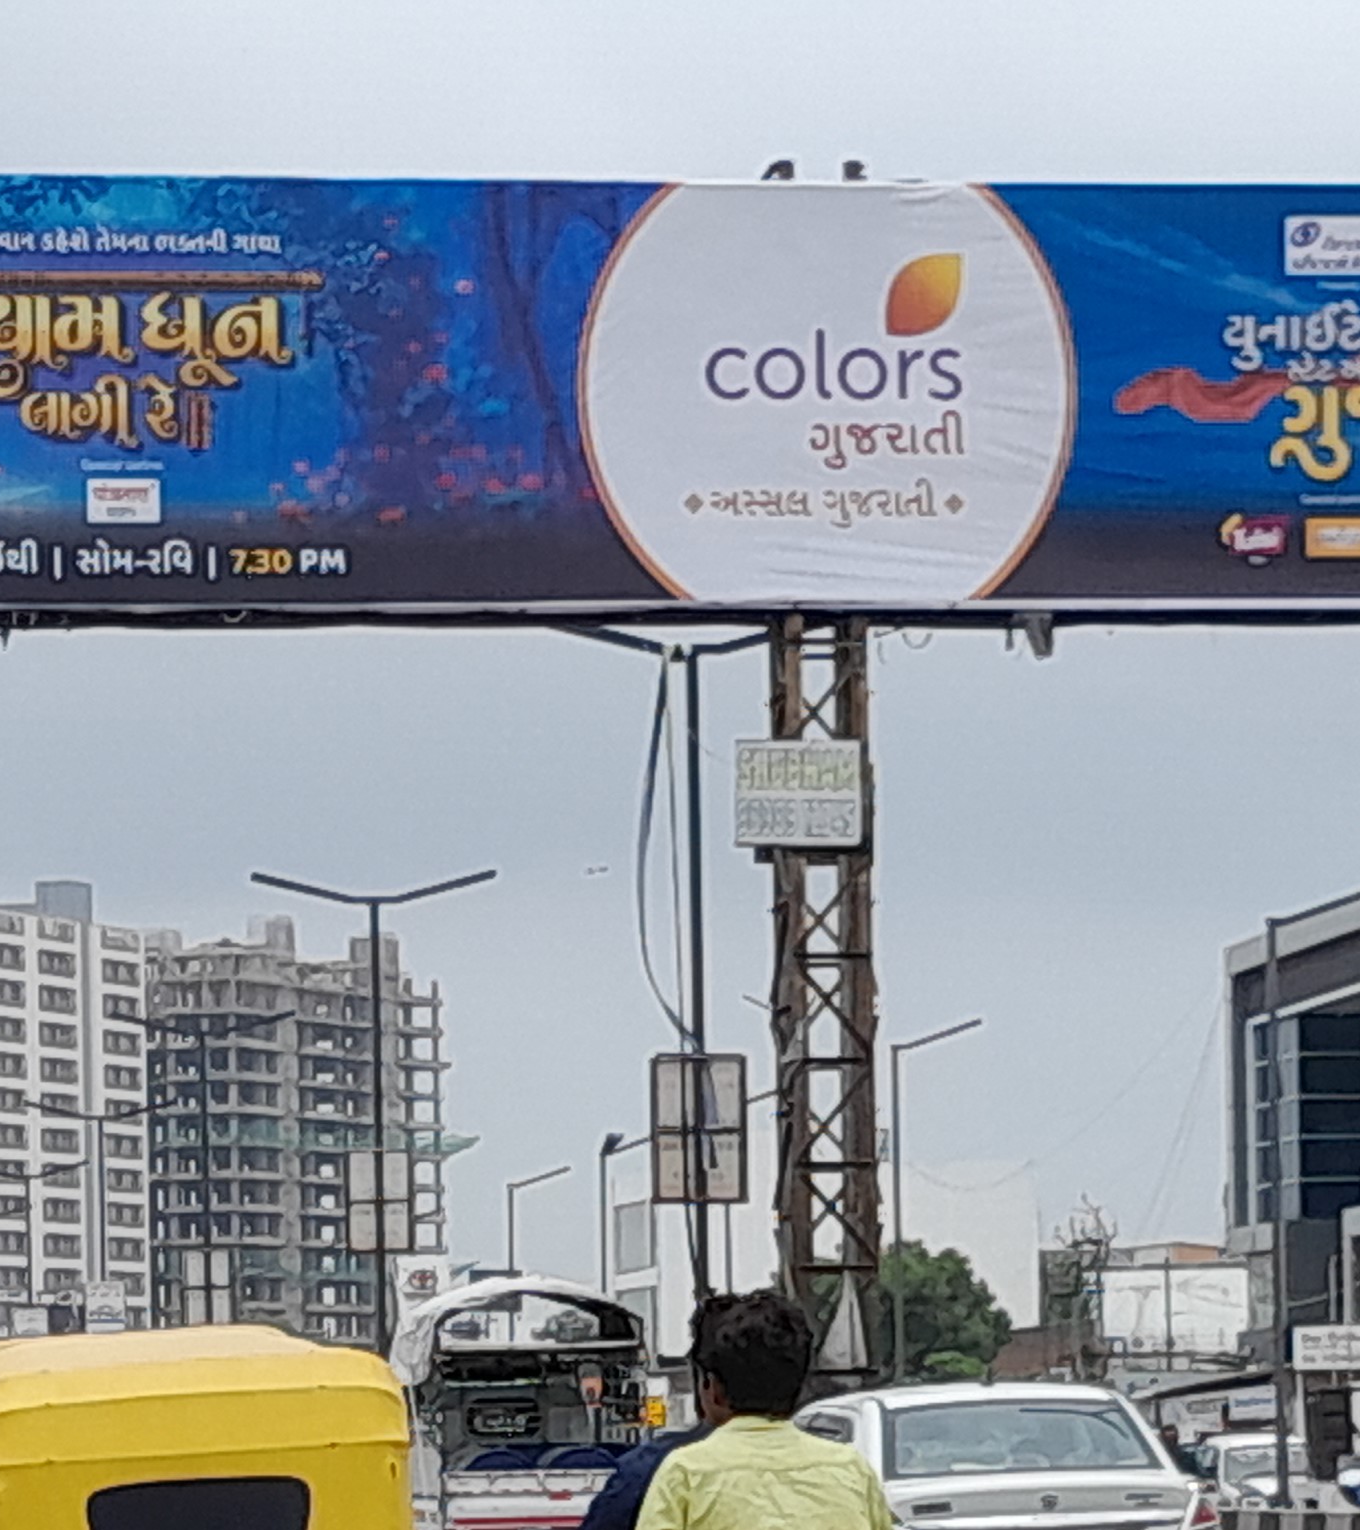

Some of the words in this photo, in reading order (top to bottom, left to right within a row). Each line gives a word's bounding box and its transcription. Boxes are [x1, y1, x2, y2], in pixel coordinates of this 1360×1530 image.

[141, 290, 293, 388] ધૂન
[705, 328, 964, 400] colors
[809, 410, 966, 468] ગુજરાતી
[823, 478, 936, 527] ગુજરાતી
[299, 548, 346, 574] PM
